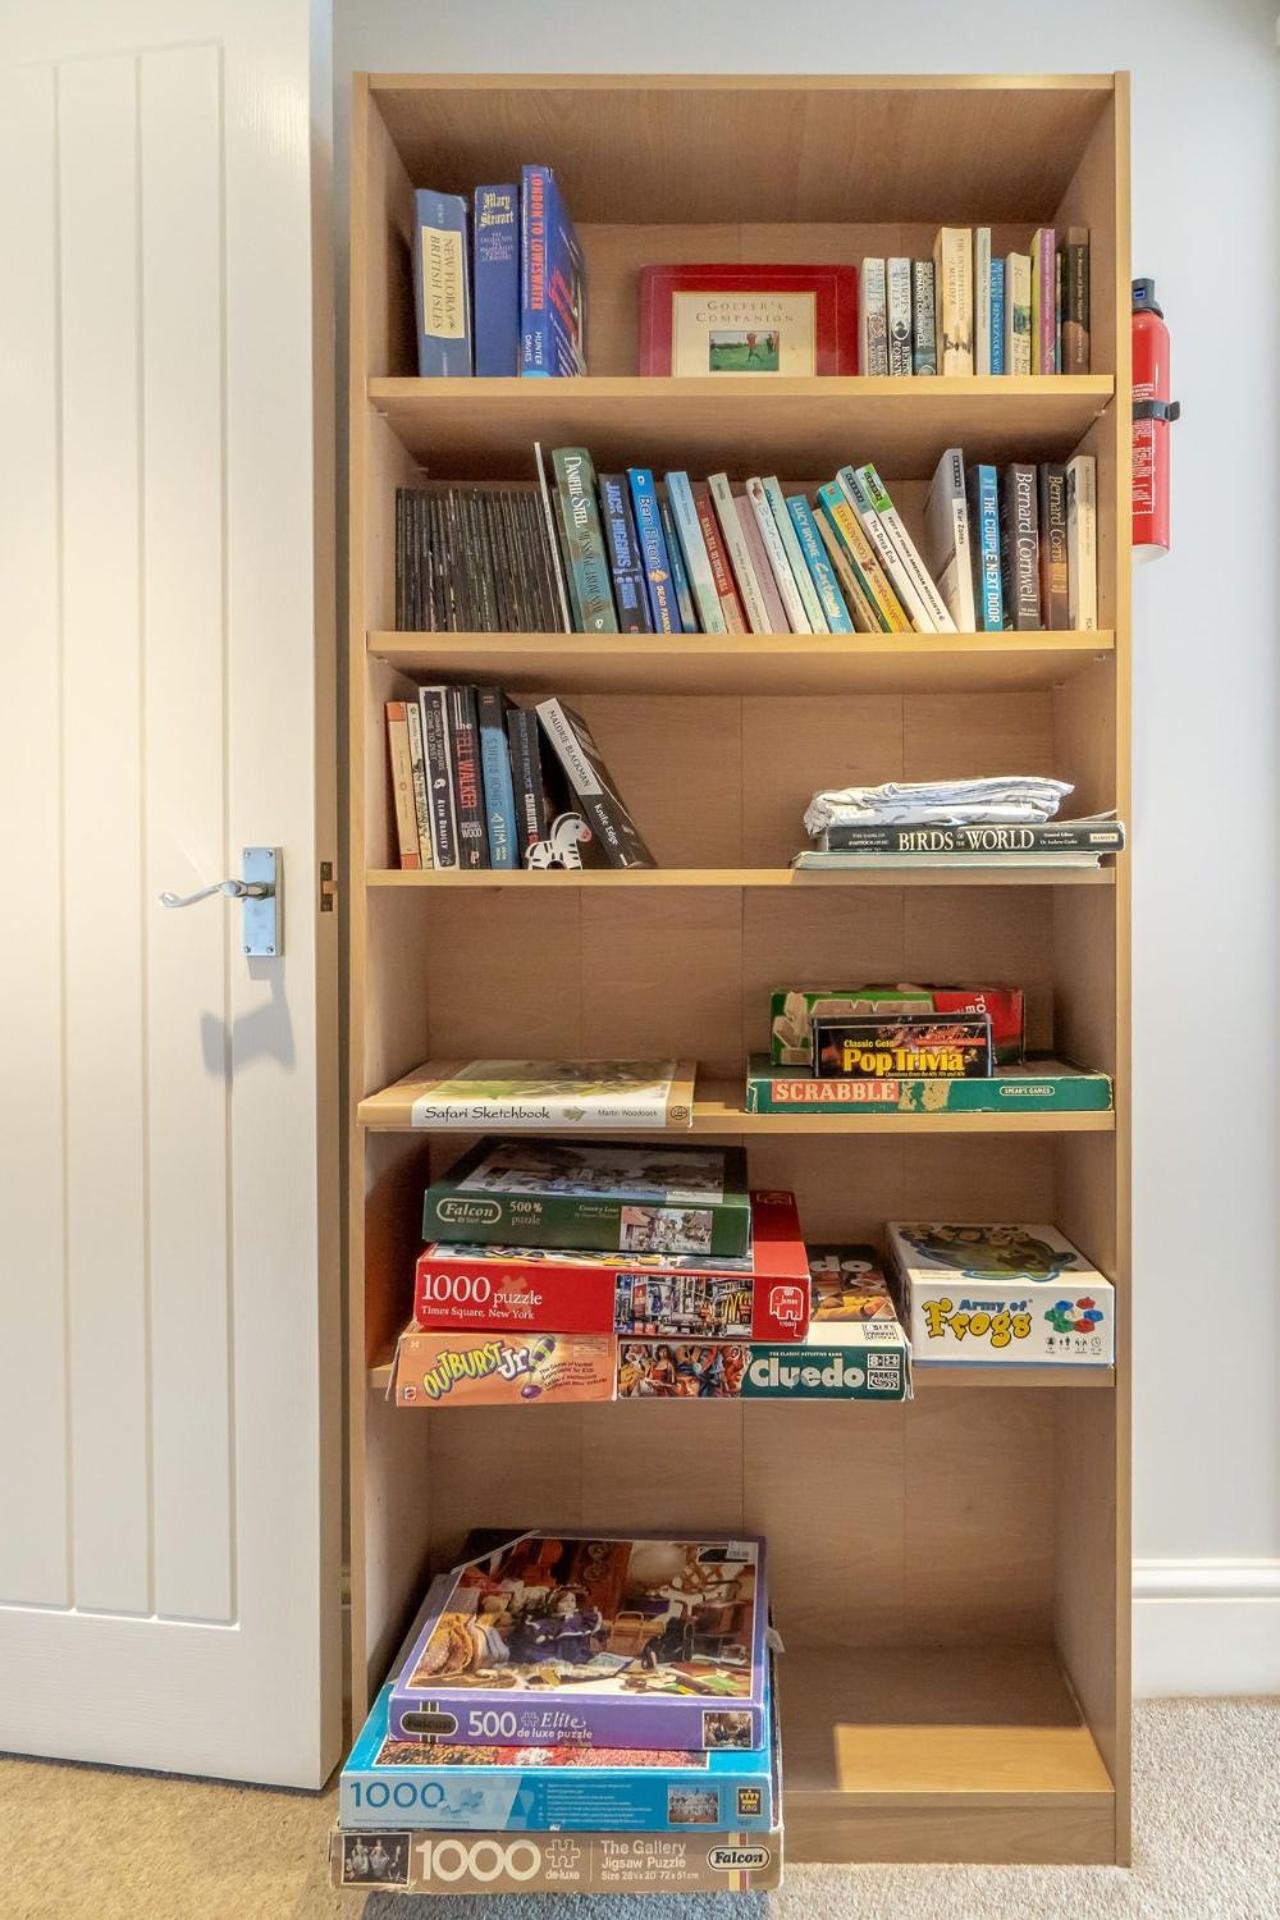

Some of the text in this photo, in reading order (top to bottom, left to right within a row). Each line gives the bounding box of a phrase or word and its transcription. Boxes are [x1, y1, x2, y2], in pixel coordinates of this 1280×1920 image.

[483, 191, 511, 209] Mary
[480, 211, 514, 227] Stewart
[444, 238, 456, 267] NEW
[530, 172, 545, 310] LONDON TO LOWESWATER
[430, 234, 443, 329] BRITISH ISLES
[445, 271, 456, 313] FLORA
[696, 312, 794, 323] COMPANION
[707, 301, 784, 311] GOLFER'S
[915, 262, 925, 348] BERNARD CORNWELL
[524, 334, 533, 362] DAVIES
[533, 331, 543, 365] HUNTER
[563, 456, 591, 528] DANIELLE STEEL
[605, 480, 623, 514] JACK
[1016, 471, 1037, 533] Bernard
[1048, 474, 1065, 526] Bernard
[611, 518, 632, 569] HIGGINS
[639, 495, 661, 570] Ben Elton
[793, 501, 821, 561] LUCY IRVINE
[870, 519, 896, 565] The Deep End
[957, 523, 965, 545] Zones
[983, 496, 1000, 623] THE COUPLE NEXT DOOR
[1017, 537, 1037, 602] Cornwell
[656, 585, 666, 607] DEAD
[815, 562, 843, 618] Castaway
[910, 558, 927, 586] AMERICAN
[924, 585, 943, 616] NOVELISTS
[428, 731, 436, 743] TO
[550, 709, 591, 788] MALORIE BLACKMAN
[455, 730, 477, 809] FELL WALKER
[437, 799, 449, 849] ALAN BRADLEY
[524, 792, 538, 834] CHARLOTTE
[593, 803, 619, 846] Knife Edge
[461, 828, 482, 839] WOOD
[490, 812, 507, 845] WILD
[898, 831, 955, 851] BIRDS
[965, 829, 1035, 850] WORLD
[843, 1039, 897, 1048] Classic Gold
[843, 1049, 965, 1077] Pop Trivia
[775, 1081, 896, 1101] SCRABBLE
[1028, 1086, 1052, 1095] GAMES
[424, 1105, 551, 1122] Safari Sketchbook
[444, 1203, 494, 1217] Falcon
[510, 1200, 532, 1213] 500
[511, 1214, 542, 1226] puzzle
[421, 1274, 543, 1309] 1000 puzzle
[422, 1305, 535, 1320] Times Square, New York
[959, 1299, 1028, 1313] Army of
[921, 1297, 1033, 1349] Frogs
[422, 1340, 504, 1401] OUTBURST
[749, 1357, 865, 1388] Cluedo
[870, 1371, 898, 1379] PARKER
[468, 1711, 518, 1738] 500
[541, 1712, 587, 1729] Elite
[517, 1729, 593, 1742] de luxe puzzle
[350, 1781, 446, 1809] 1000
[415, 1838, 542, 1882] 1000
[601, 1840, 687, 1857] The Gallery
[714, 1852, 764, 1864] Falcon
[601, 1857, 687, 1870] Jigsaw Puzzle
[601, 1871, 620, 1881] Size
